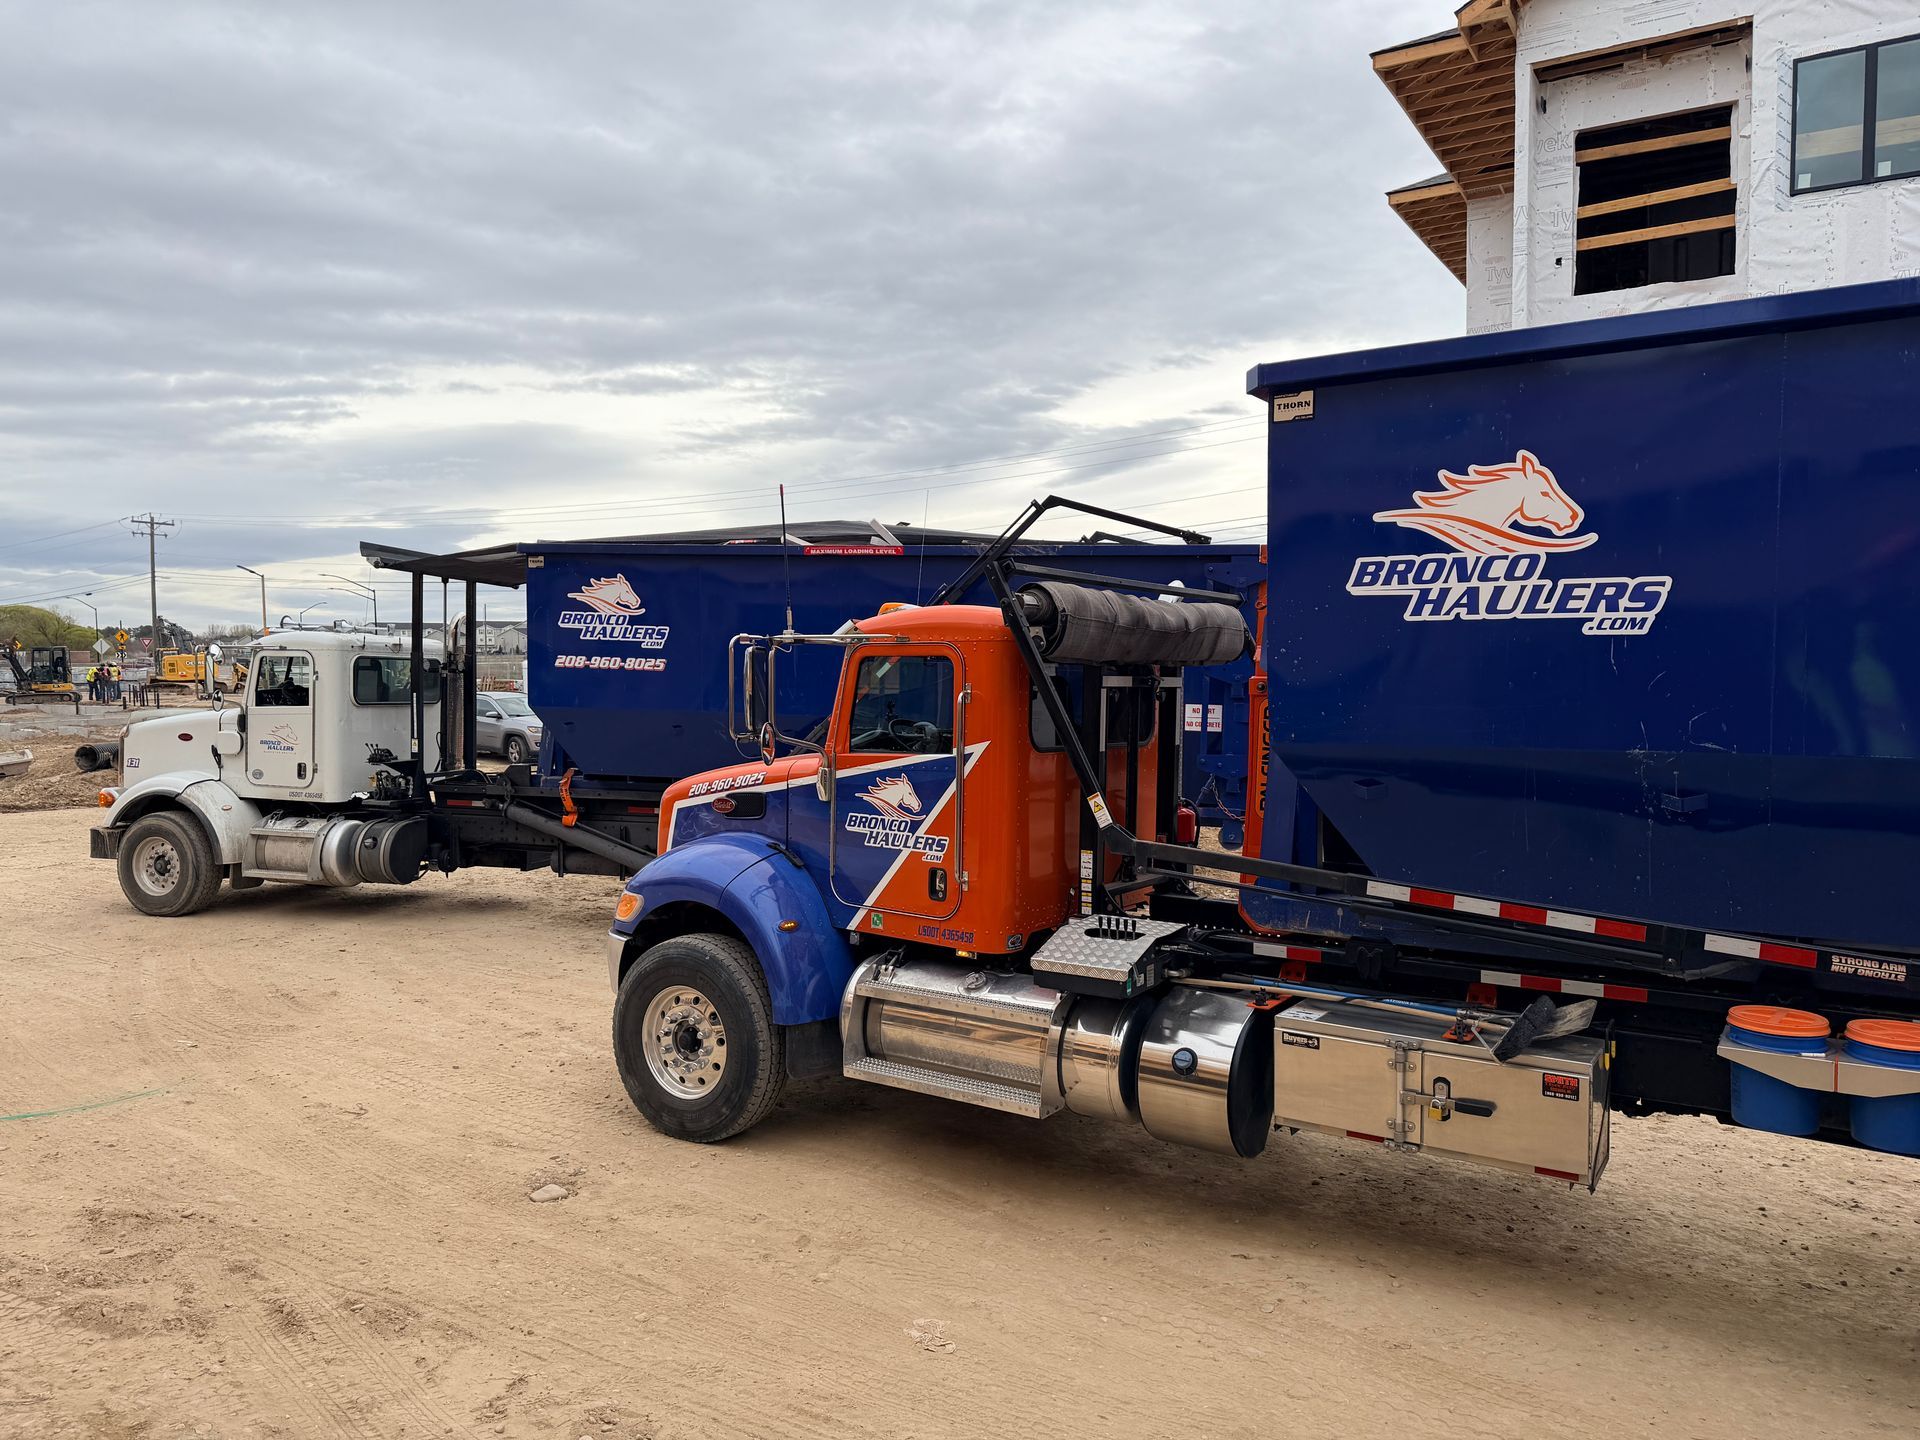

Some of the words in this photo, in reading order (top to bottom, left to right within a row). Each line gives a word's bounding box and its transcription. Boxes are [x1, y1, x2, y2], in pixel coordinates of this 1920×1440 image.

[1276, 400, 1311, 410] THORN
[1350, 553, 1543, 588] BRONCO
[1405, 580, 1670, 617] HAULERS
[560, 612, 628, 626] BRONCO
[1587, 616, 1647, 631] .COM
[582, 626, 668, 640] HAULERS
[555, 655, 667, 671] 208-960-8025
[1195, 721, 1221, 729] CORETE
[127, 758, 140, 768] 131
[688, 771, 767, 798] 208-960-8025
[847, 814, 909, 832] BRONCO
[866, 831, 948, 853] HAULERS
[923, 854, 942, 862] .COM
[917, 925, 940, 939] USDOT
[941, 929, 975, 944] 4365458
[1830, 964, 1856, 975] ARM
[1831, 955, 1880, 969] STRONG
[1881, 963, 1907, 973] ARM
[1856, 968, 1906, 982] STRONG
[1283, 1032, 1308, 1044] Buyers
